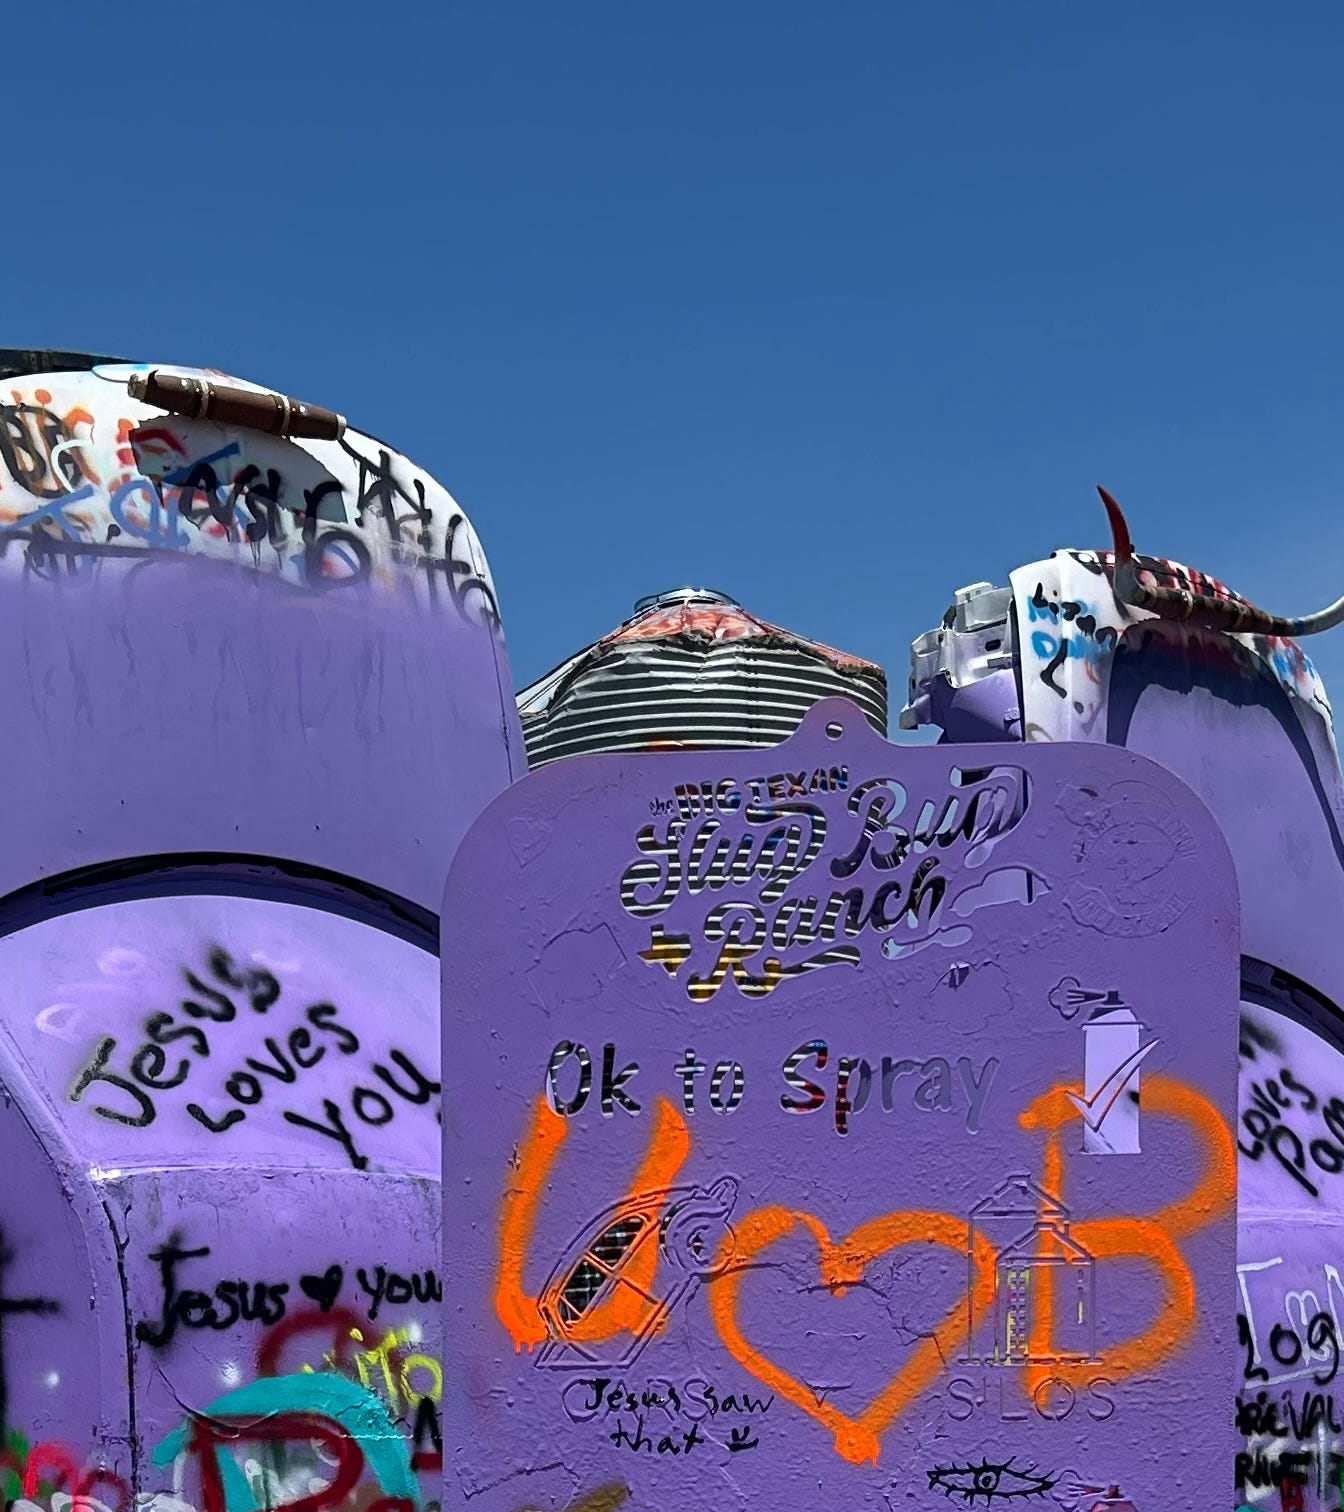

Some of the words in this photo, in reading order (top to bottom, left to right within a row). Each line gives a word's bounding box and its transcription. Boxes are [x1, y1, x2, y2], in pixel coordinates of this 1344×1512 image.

[674, 777, 742, 821] BIG
[744, 764, 849, 803] TEXAN
[619, 802, 828, 918] Slug
[829, 764, 1035, 880] Bug
[686, 855, 968, 1002] Ranch
[545, 1039, 642, 1118] Ok
[674, 1046, 746, 1114] to
[780, 1039, 1000, 1136] Spray
[609, 1413, 705, 1456] that
[943, 1375, 1117, 1424] SILOS
